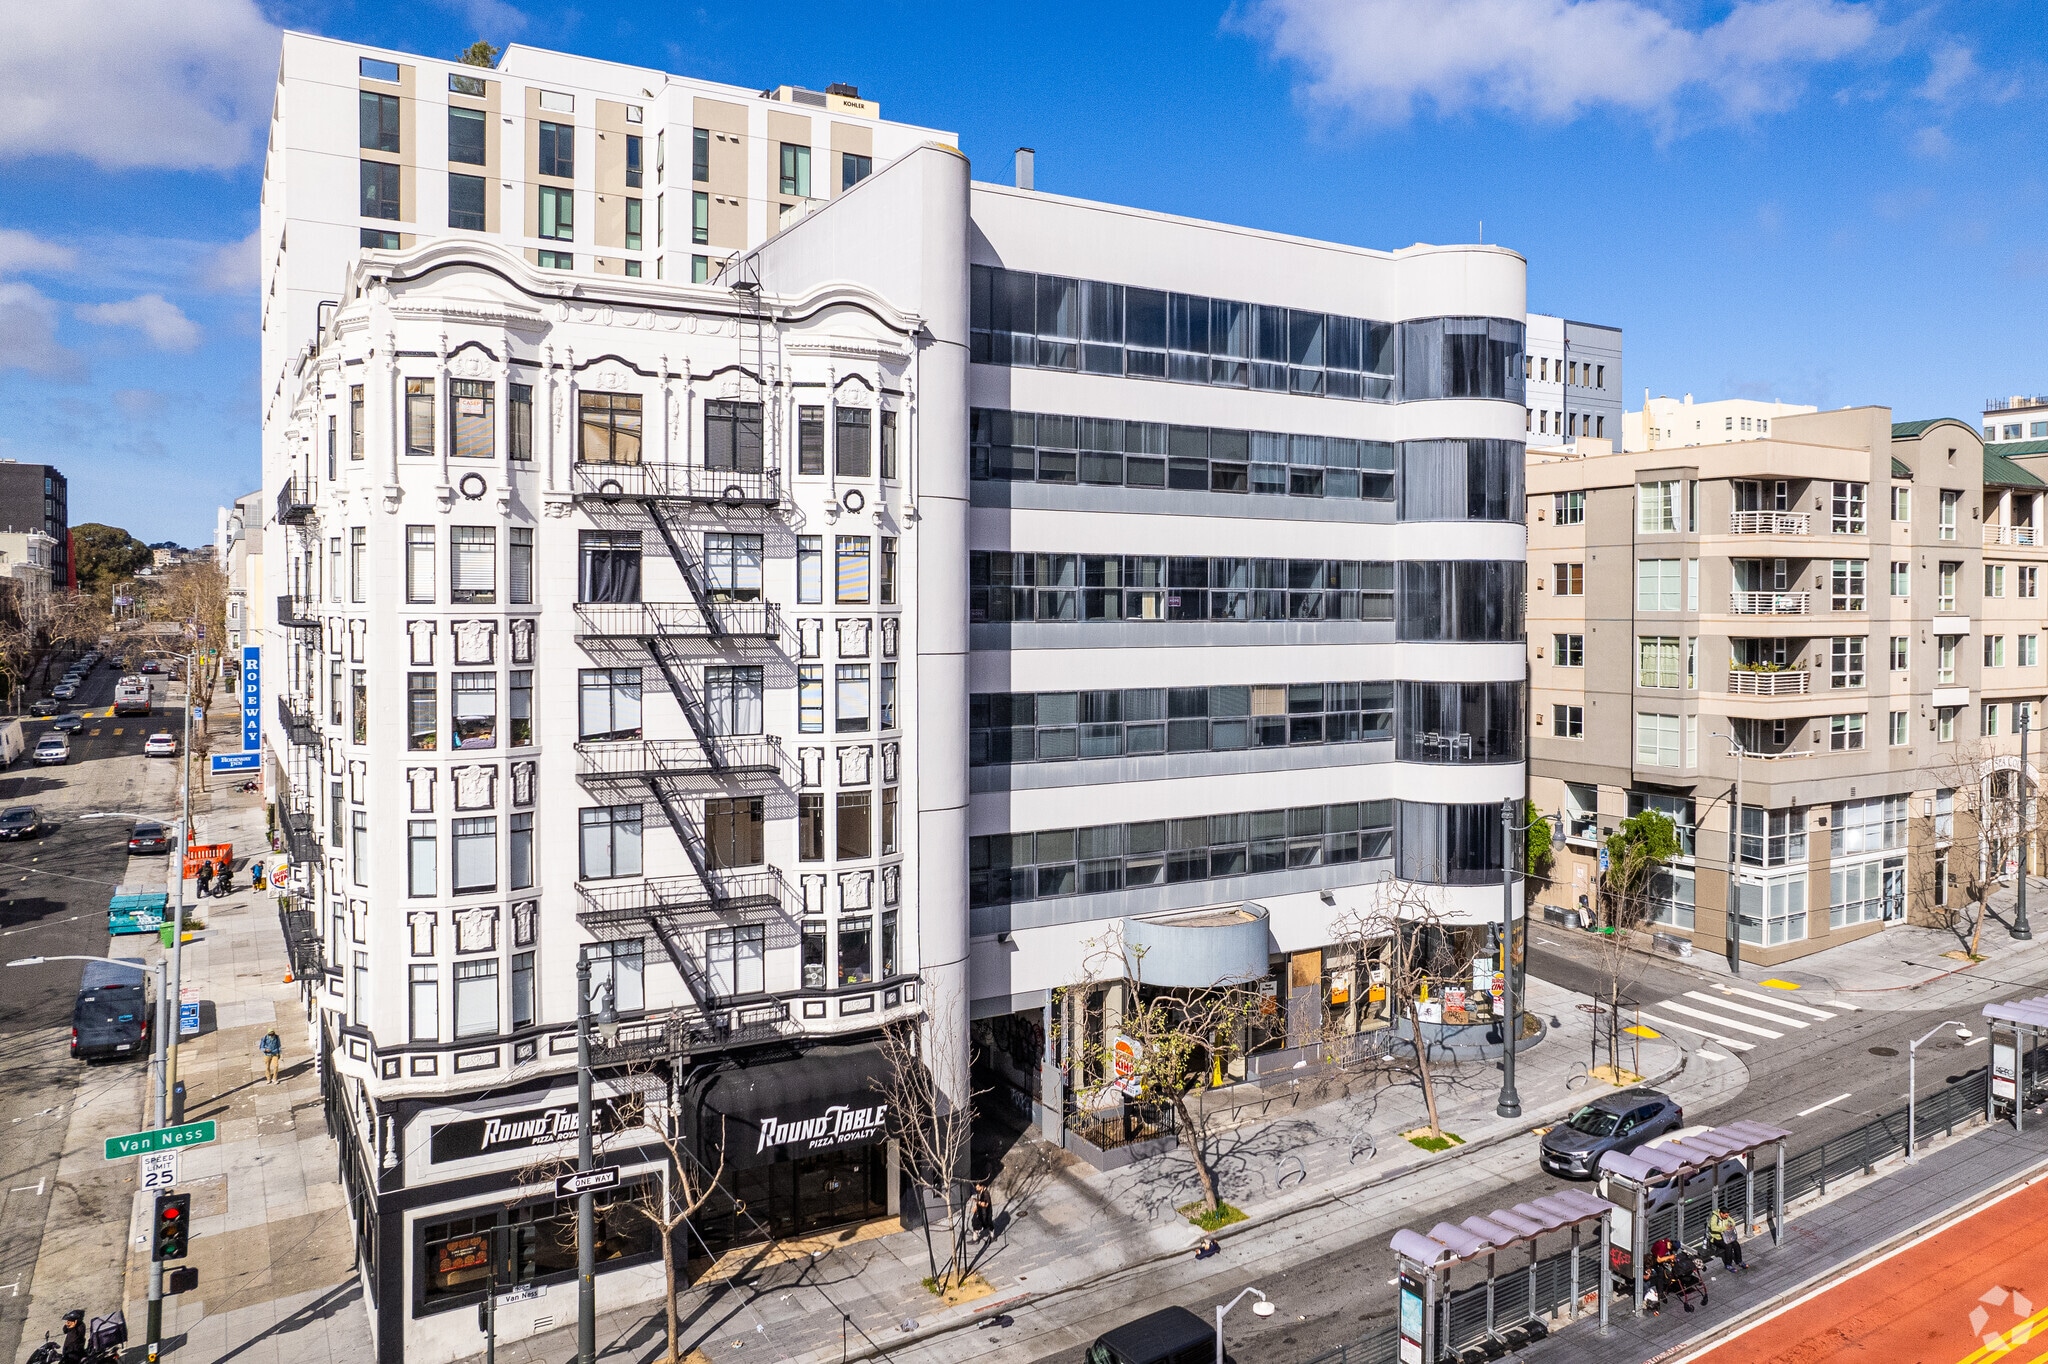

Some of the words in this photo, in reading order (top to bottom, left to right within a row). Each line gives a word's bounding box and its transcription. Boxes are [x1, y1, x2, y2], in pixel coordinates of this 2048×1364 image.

[843, 100, 865, 109] KOHLER
[245, 659, 259, 741] RODEWAY
[481, 1119, 552, 1150] ROUND
[545, 1108, 602, 1136] TABE
[757, 1117, 833, 1154] ROUND
[825, 1104, 888, 1137] TABLE
[120, 1139, 150, 1152] Van
[162, 1129, 203, 1145] Ness
[532, 1136, 553, 1144] PIZZA
[809, 1137, 833, 1149] PIZZA
[837, 1128, 876, 1143] ROYALTY
[145, 1155, 174, 1165] SPEED
[147, 1162, 171, 1172] LIMIT
[145, 1170, 173, 1187] 25
[575, 1178, 591, 1187] ONE
[595, 1174, 611, 1182] WAY
[521, 1291, 538, 1299] Ness
